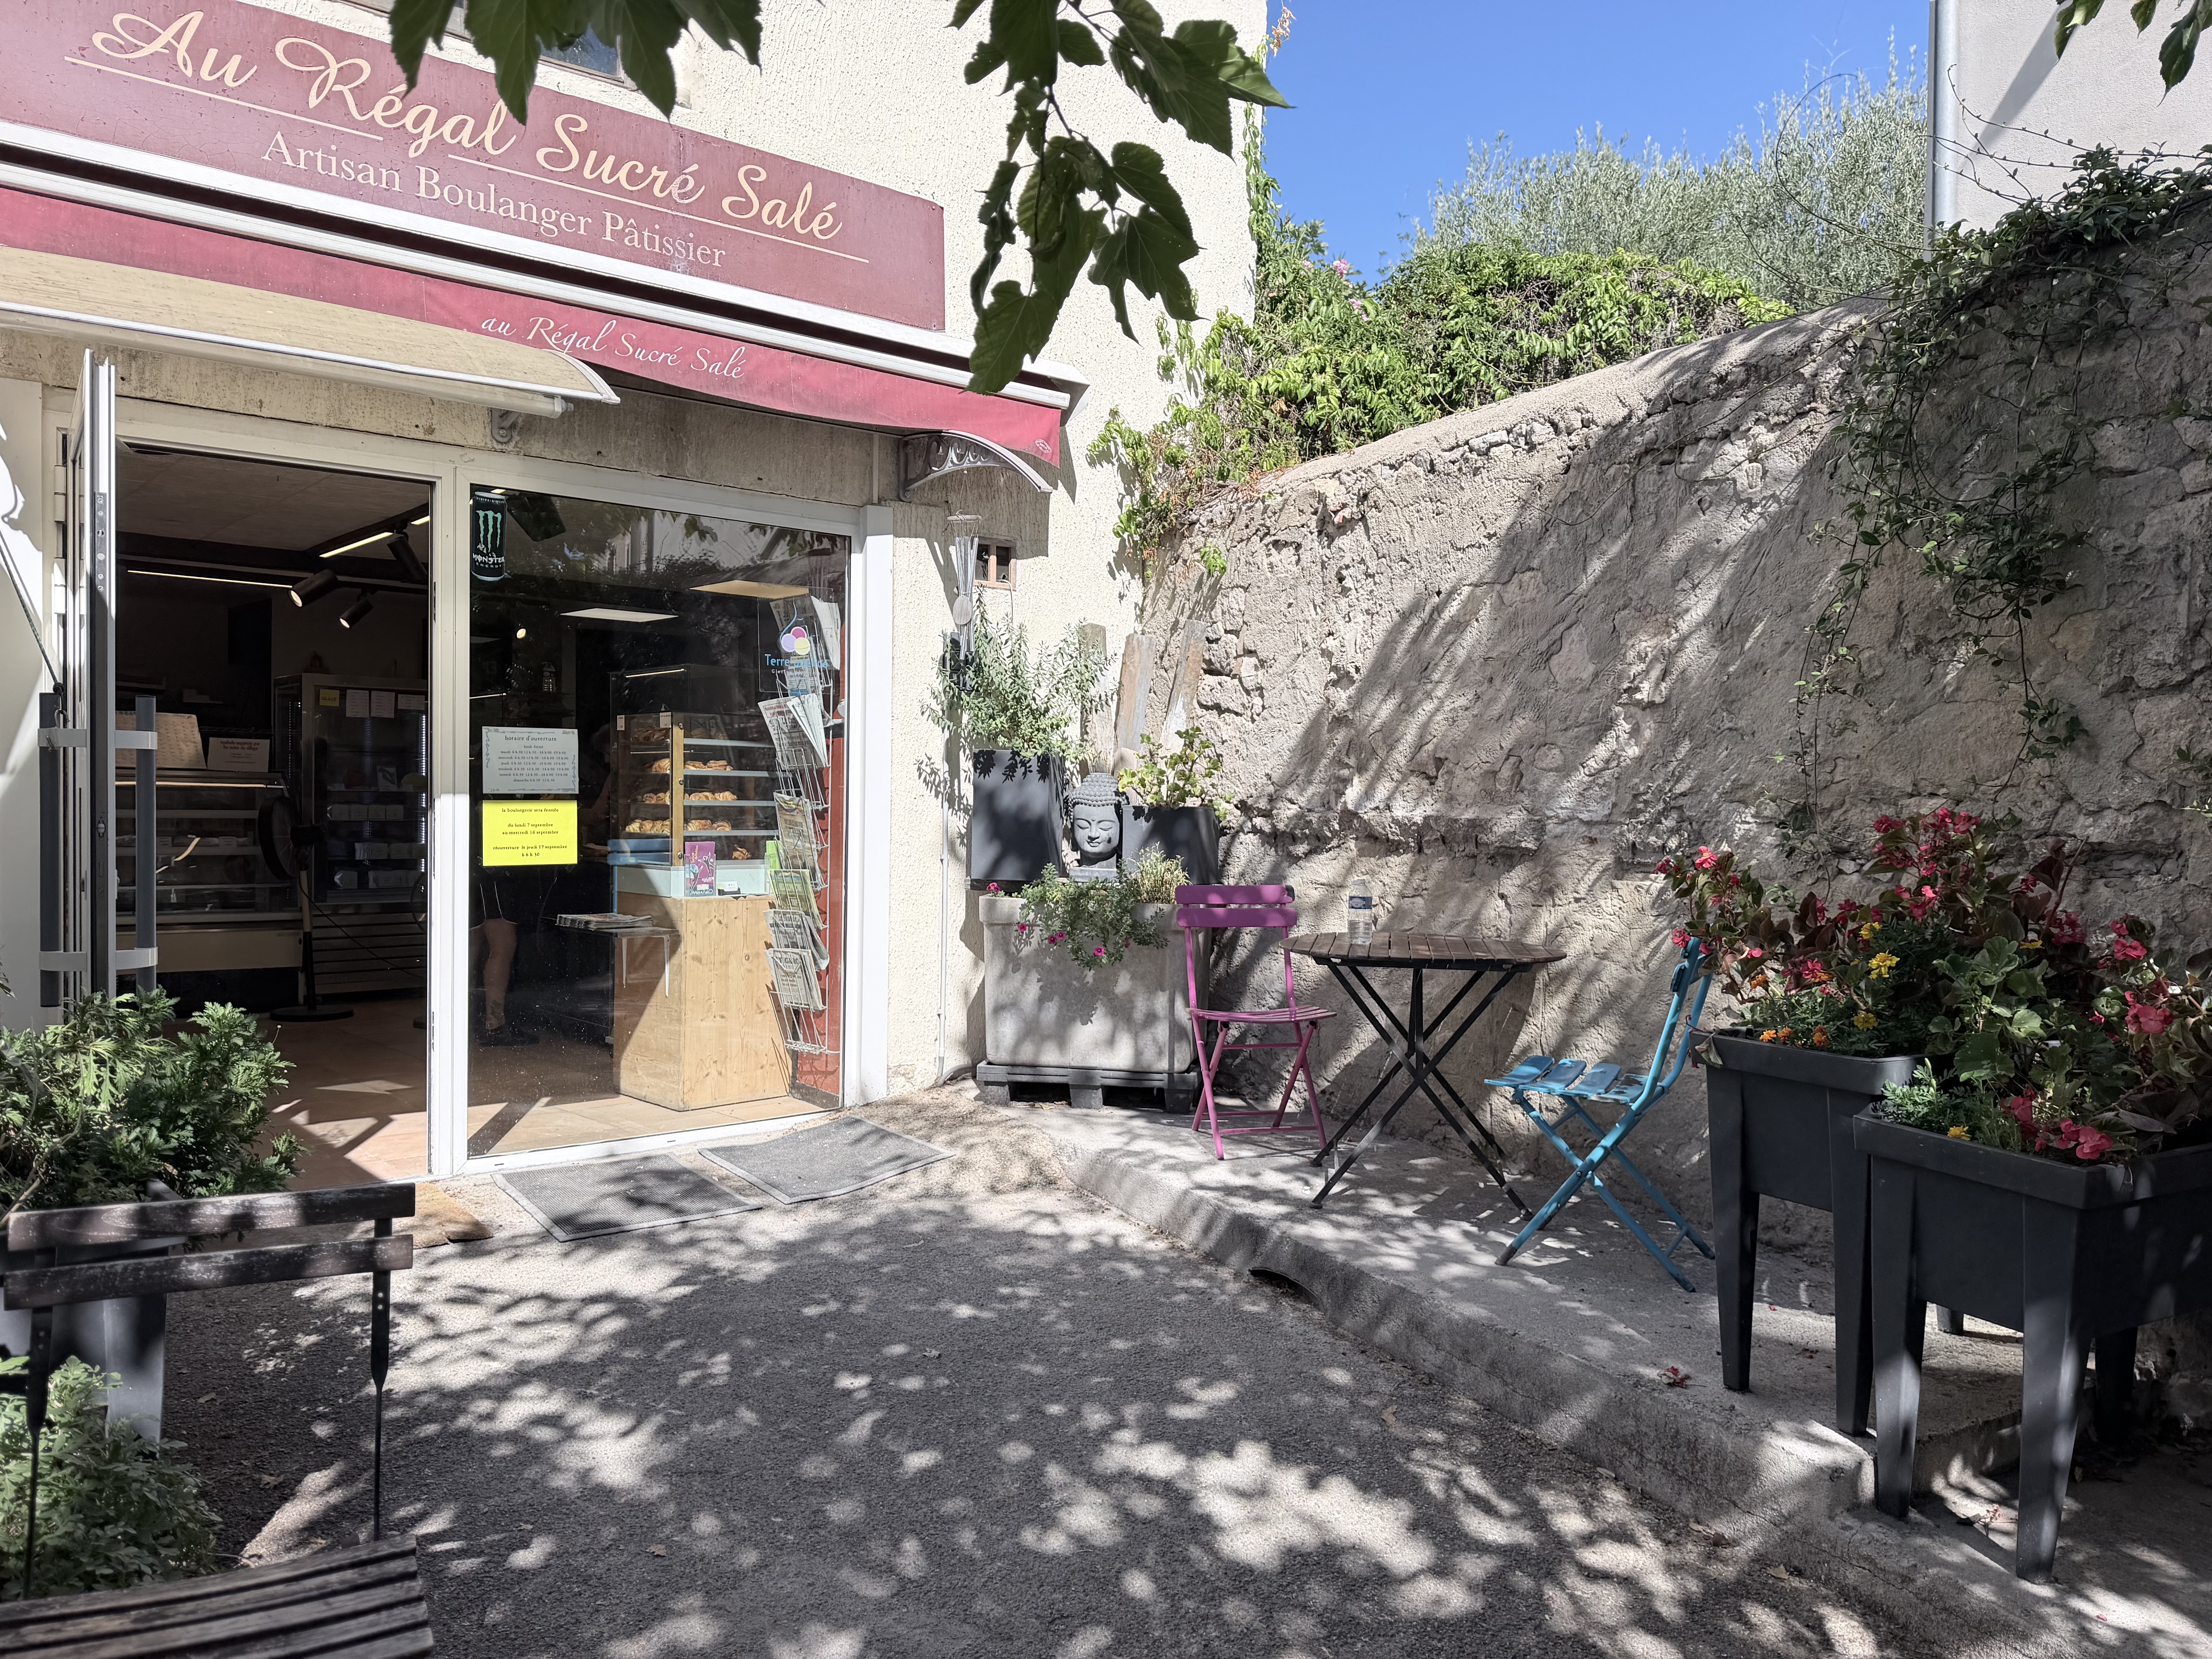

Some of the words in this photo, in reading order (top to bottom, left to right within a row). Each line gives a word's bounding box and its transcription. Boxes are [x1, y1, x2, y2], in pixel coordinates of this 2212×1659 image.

[92, 10, 257, 88] Au
[275, 37, 517, 158] Régal
[536, 113, 705, 203] Sucré
[721, 164, 843, 240] Salé
[261, 131, 402, 192] Artisan
[414, 165, 592, 237] Boulanger
[602, 211, 726, 268] Pâtissier
[481, 317, 515, 337] au
[526, 316, 617, 354] Régal
[614, 333, 682, 366] Sucré
[690, 346, 747, 379] Salé
[472, 553, 505, 564] MONSTER
[765, 654, 790, 666] Terre
